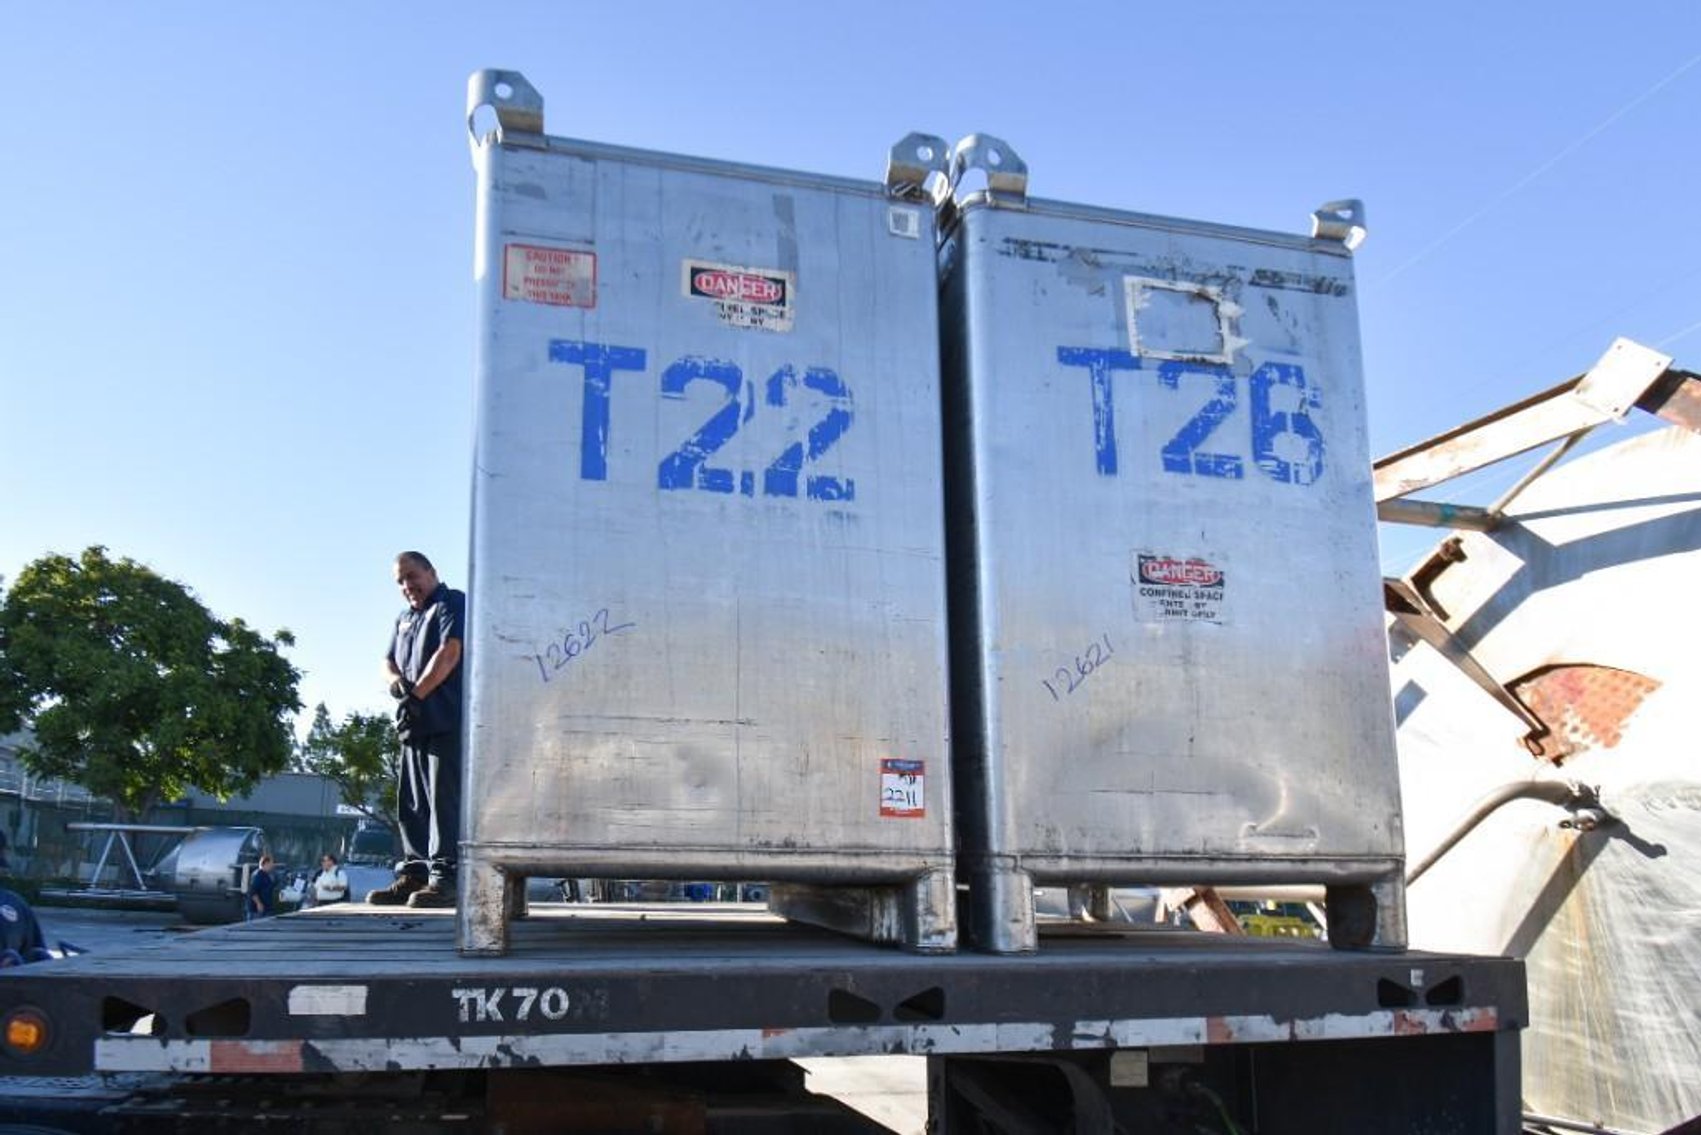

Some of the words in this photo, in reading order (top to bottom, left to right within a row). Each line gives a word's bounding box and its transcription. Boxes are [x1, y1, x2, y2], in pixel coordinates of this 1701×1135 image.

[548, 339, 856, 501] T22
[1057, 345, 1327, 486] T26
[535, 607, 636, 683] 12622
[1042, 632, 1115, 701] 12621
